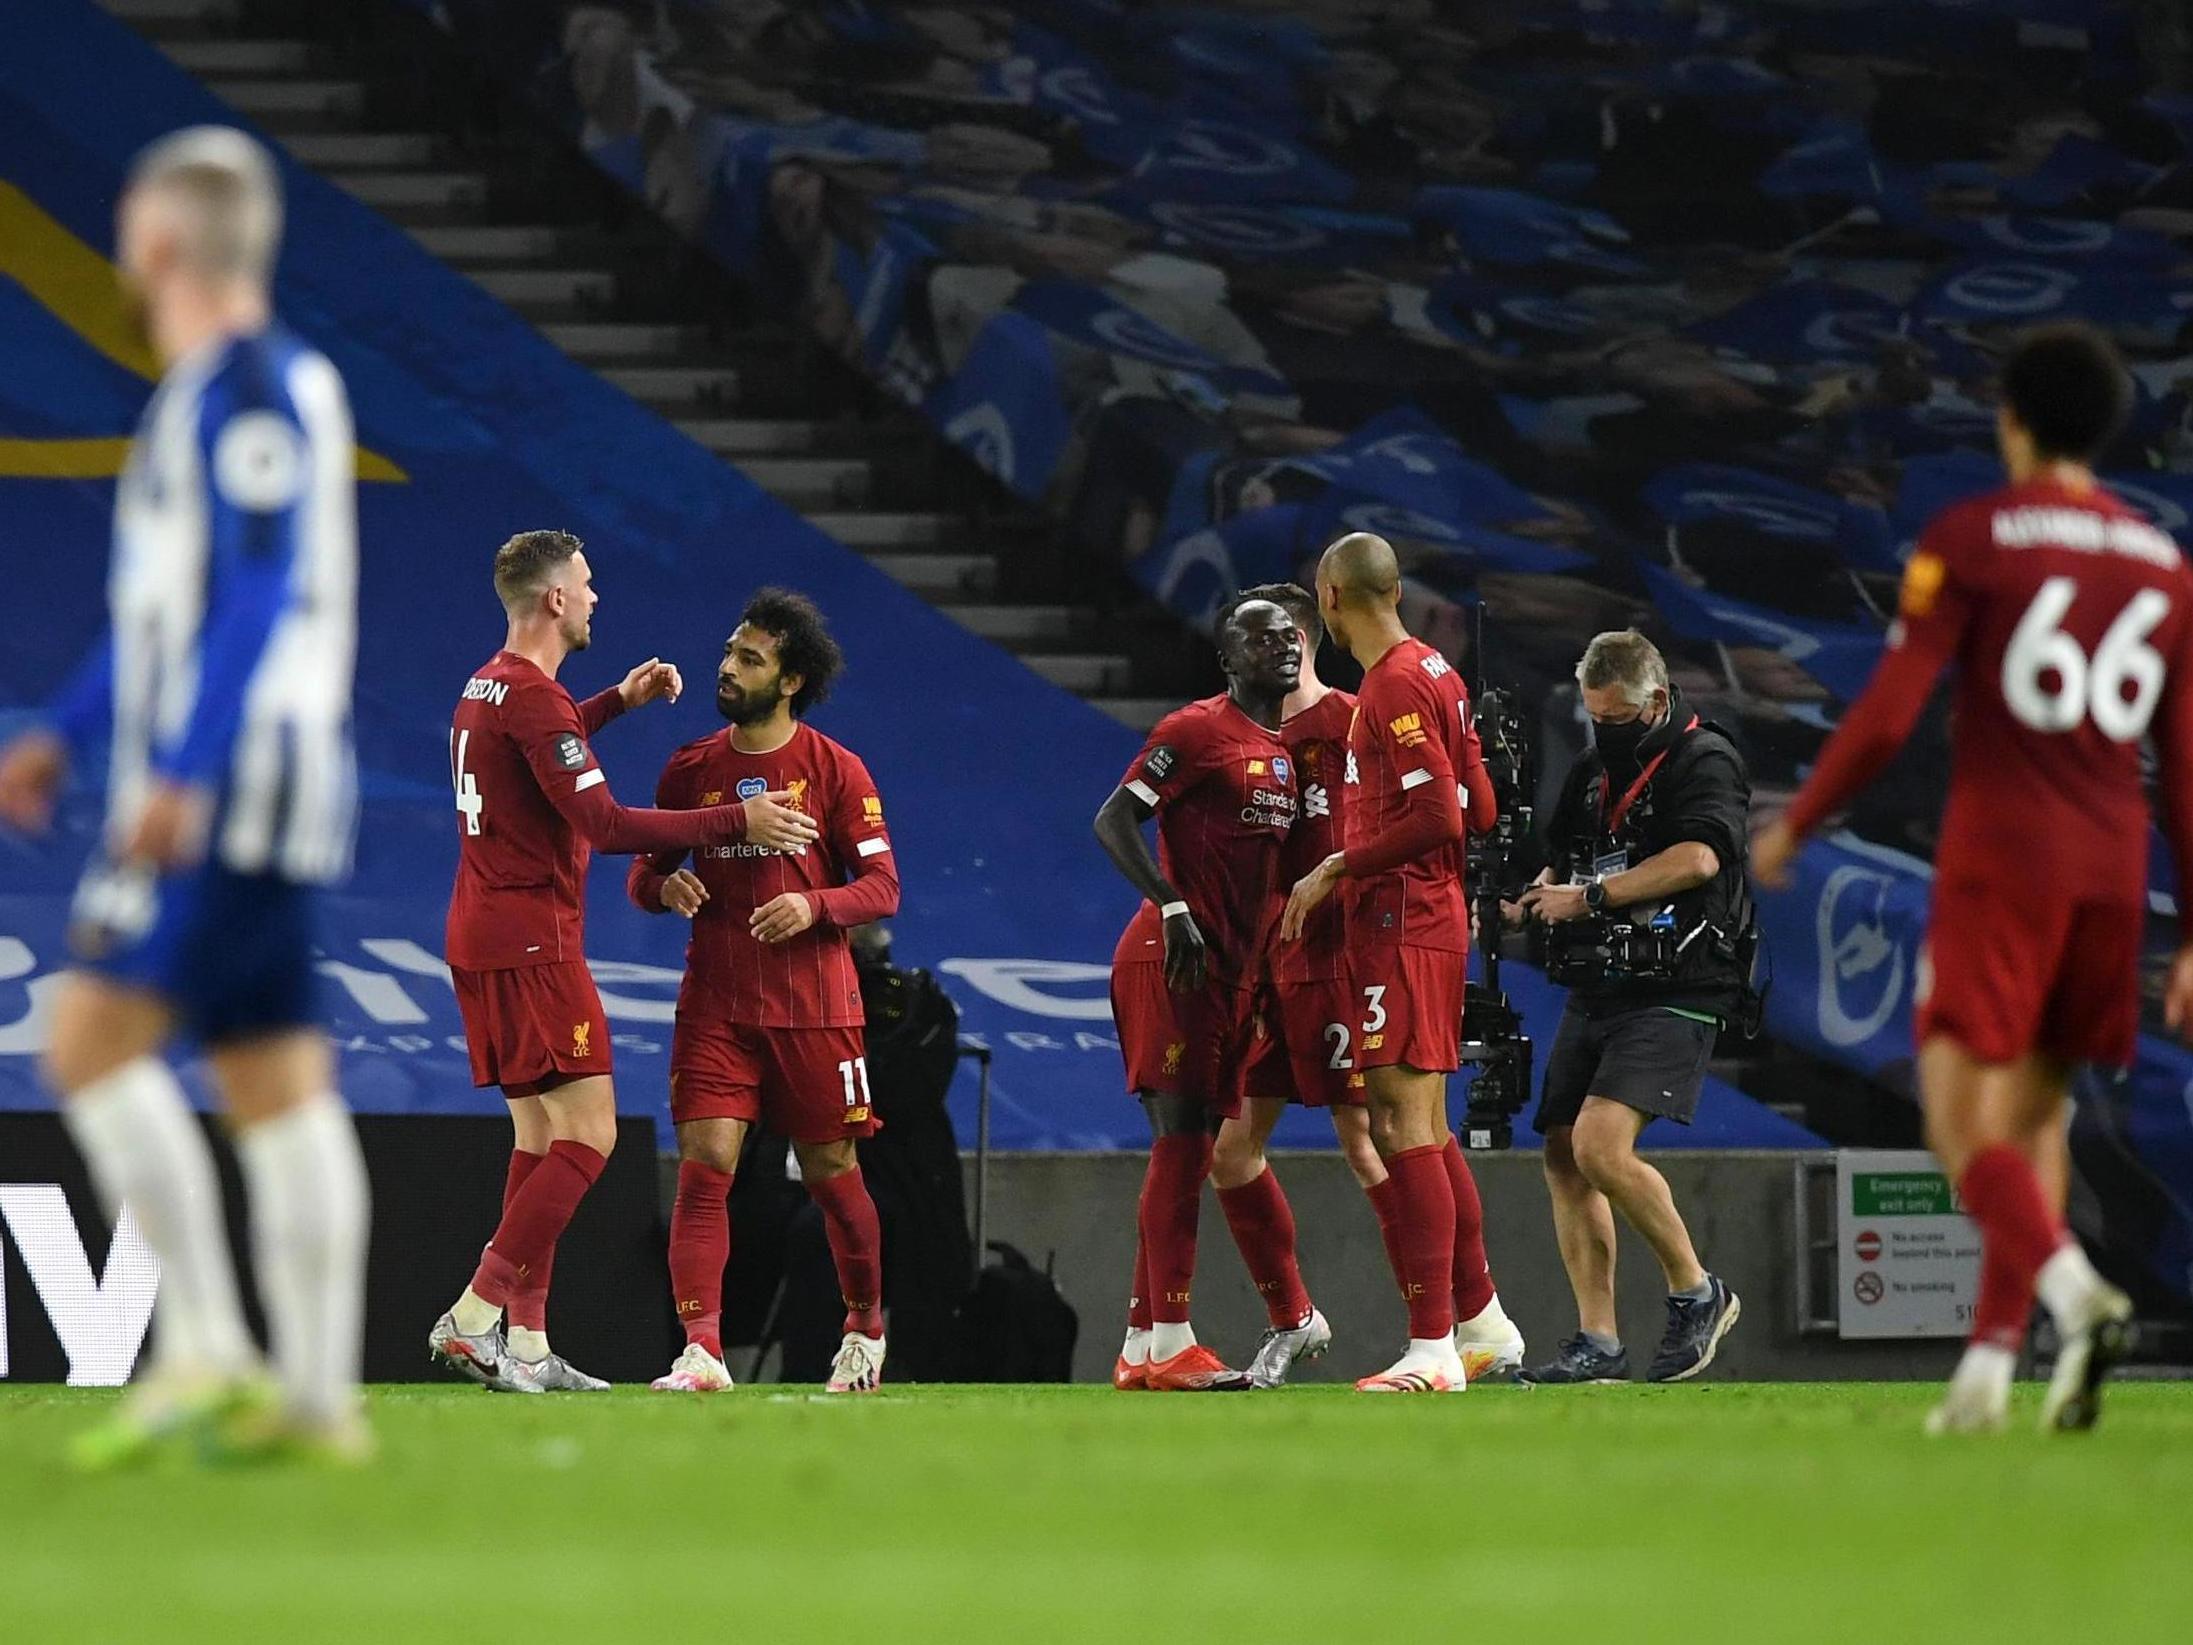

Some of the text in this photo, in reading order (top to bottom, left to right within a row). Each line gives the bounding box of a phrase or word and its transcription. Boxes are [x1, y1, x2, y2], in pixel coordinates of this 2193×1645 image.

[2002, 576, 2168, 742] 66
[1362, 985, 1386, 1032] 3
[1324, 1023, 1353, 1069] 2
[838, 1056, 871, 1106] 11
[1870, 1178, 1942, 1194] Emergency
[1879, 1199, 1934, 1213] exit only
[1892, 1232, 1907, 1241] No
[1892, 1282, 1955, 1293] No smoking
